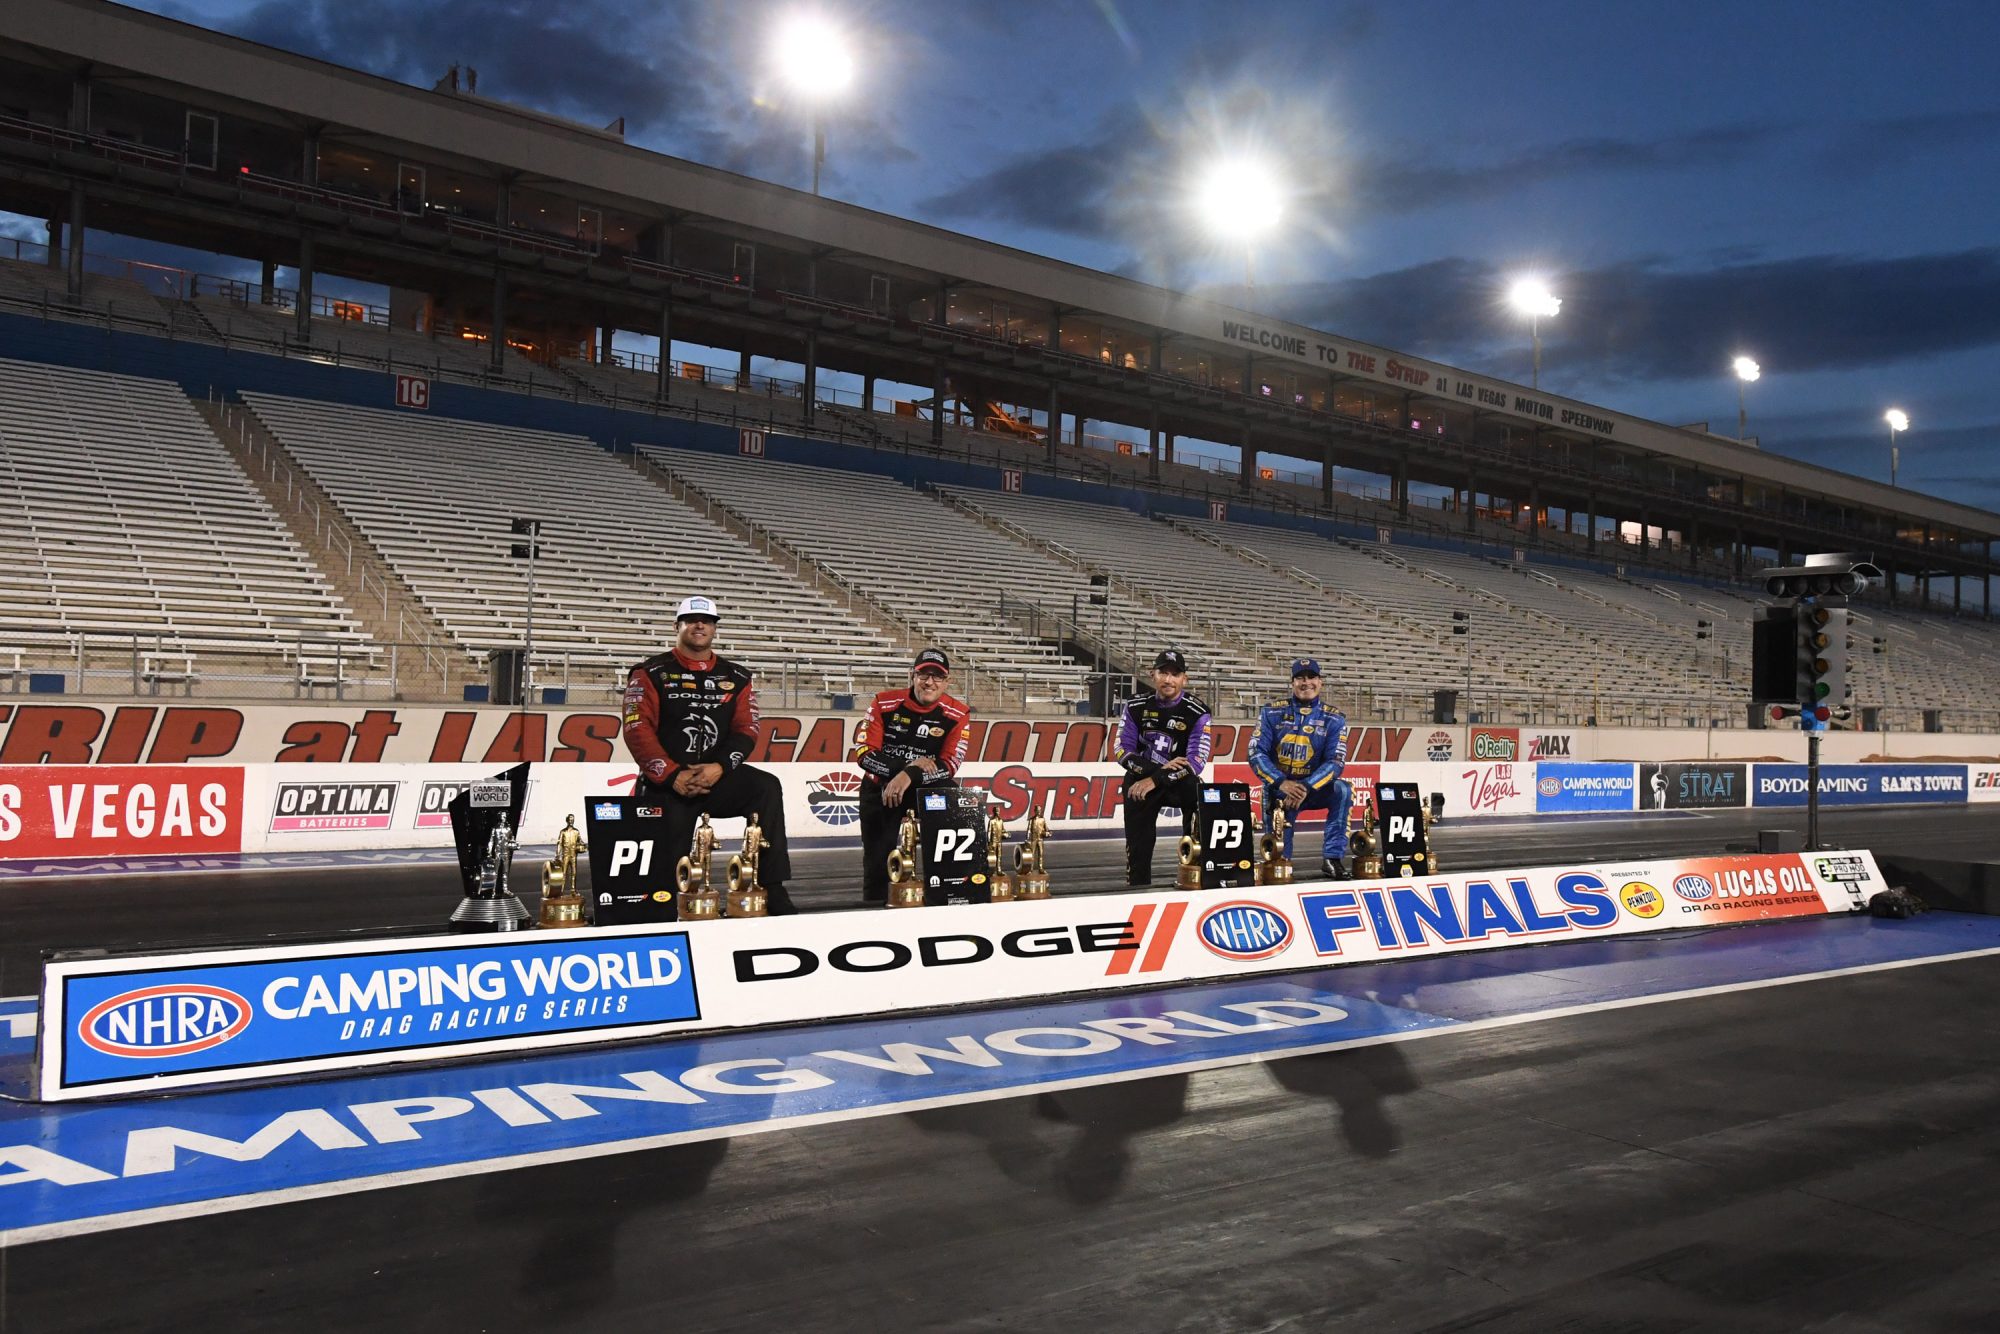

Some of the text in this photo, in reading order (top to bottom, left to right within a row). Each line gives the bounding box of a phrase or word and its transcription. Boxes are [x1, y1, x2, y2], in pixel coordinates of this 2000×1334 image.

[1222, 320, 1306, 357] WELCOME
[1316, 344, 1338, 364] TO
[1346, 350, 1376, 374] THE
[1456, 381, 1473, 400] LAS
[1478, 387, 1506, 408] VEGAS
[1514, 396, 1554, 420] MOTOR
[1560, 408, 1616, 436] SPEEDWAY
[400, 379, 426, 405] 1C
[743, 431, 763, 454] 1D
[1003, 470, 1020, 493] 1E
[1211, 503, 1226, 521] 1F
[668, 692, 726, 700] DODGE
[275, 711, 402, 763] at
[430, 711, 621, 763] LAS
[1475, 735, 1515, 760] O'Reilly
[1281, 742, 1309, 760] NAPA
[1495, 765, 1511, 779] LAS
[1562, 777, 1633, 790] CAMPING WORLD
[1680, 772, 1736, 797] STRAT
[1881, 776, 1963, 792] SAM'S TOWN
[473, 785, 509, 793] CAMPING
[473, 793, 509, 802] WORLD
[1462, 768, 1520, 811] Vegas
[1541, 780, 1559, 793] NHRA
[48, 783, 228, 839] VEGAS
[280, 787, 390, 813] OPTIMA
[299, 817, 368, 828] BATTERIES
[1209, 820, 1244, 849] P3
[1388, 816, 1416, 843] P4
[933, 828, 976, 862] P2
[609, 840, 654, 877] P1
[1834, 865, 1848, 873] PRO
[1676, 877, 1711, 898] NHRA
[1713, 868, 1779, 898] LUCAS
[1627, 890, 1657, 908] PENNZOIL
[1682, 896, 1820, 913] DRAG RACING SERIES
[1298, 872, 1620, 957] FINALS
[1210, 910, 1284, 950] NHRA
[733, 921, 1140, 983] DODGE
[262, 950, 682, 1020] CAMPING WORLD
[108, 996, 229, 1044] NHRA
[340, 995, 629, 1041] DRAG RACING SERIES
[809, 1000, 1349, 1076] WORLD
